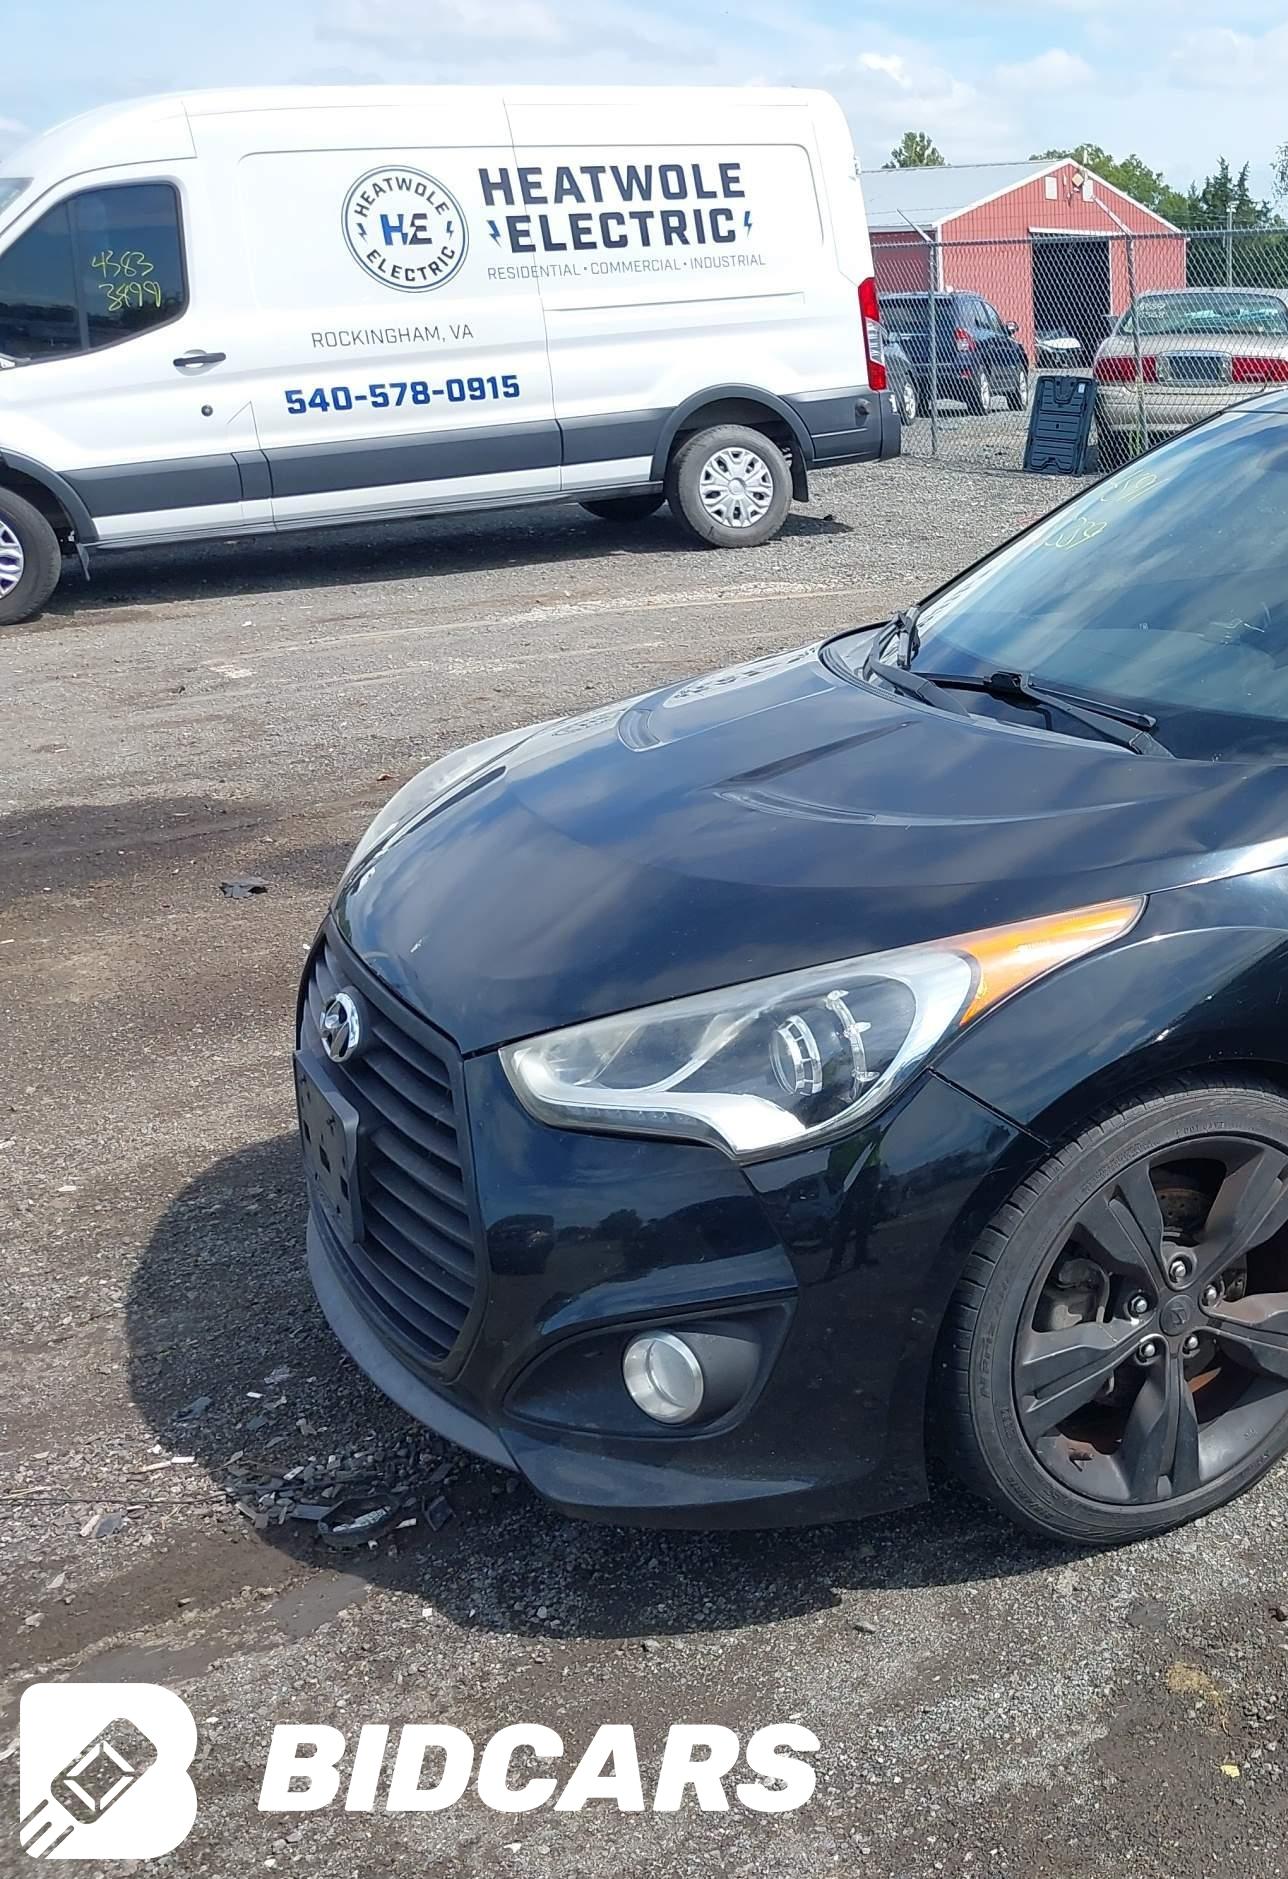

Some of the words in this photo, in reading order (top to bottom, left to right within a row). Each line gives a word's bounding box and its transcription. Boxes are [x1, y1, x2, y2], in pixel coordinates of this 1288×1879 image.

[354, 177, 450, 218] HEATWOLE
[479, 163, 745, 206] HEATWOLE
[380, 213, 432, 246] HE
[506, 208, 736, 253] ELECTRIC
[366, 246, 456, 282] ELECTRIC
[488, 263, 581, 280] RESIDENTIAL
[590, 257, 681, 275] COMMERCIAL
[690, 254, 766, 269] INDUSTRIAL
[311, 325, 446, 348] ROCKINGHAM,
[449, 323, 474, 340] VA
[285, 375, 521, 414] 540-578-0915
